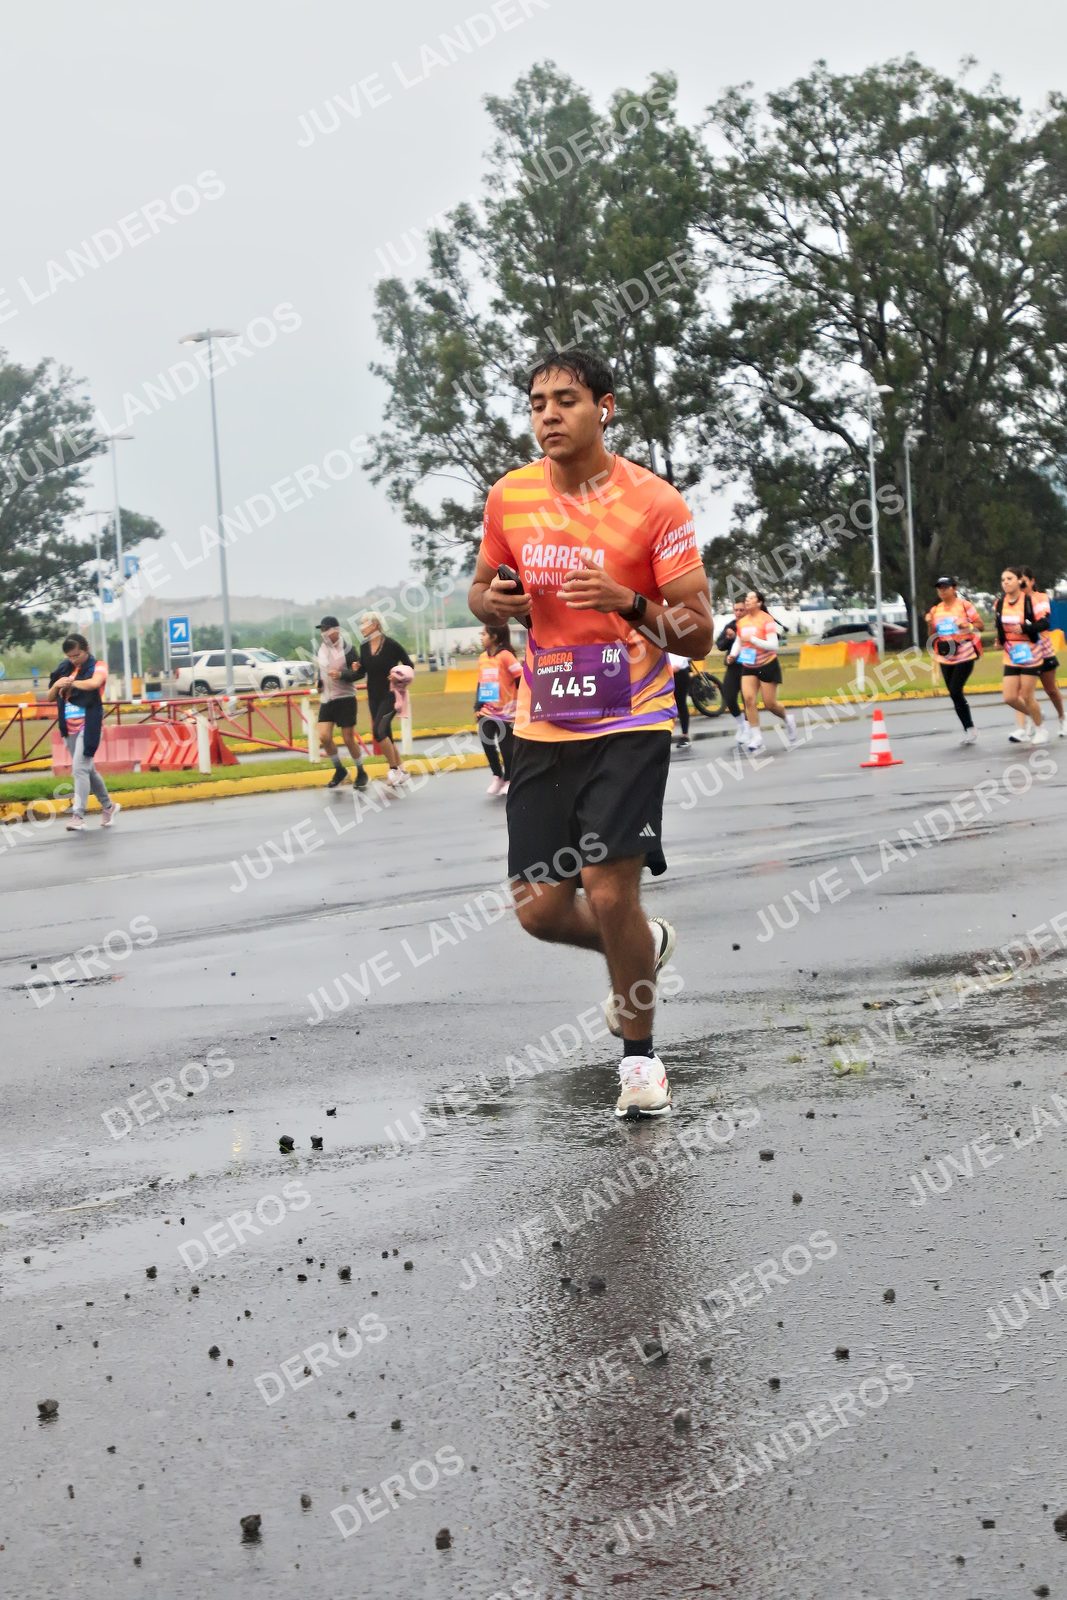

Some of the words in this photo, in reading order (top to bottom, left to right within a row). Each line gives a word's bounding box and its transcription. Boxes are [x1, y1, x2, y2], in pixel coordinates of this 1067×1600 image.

[521, 544, 605, 570] CARRERA
[538, 652, 573, 667] CARRERA
[551, 675, 597, 698] 445
